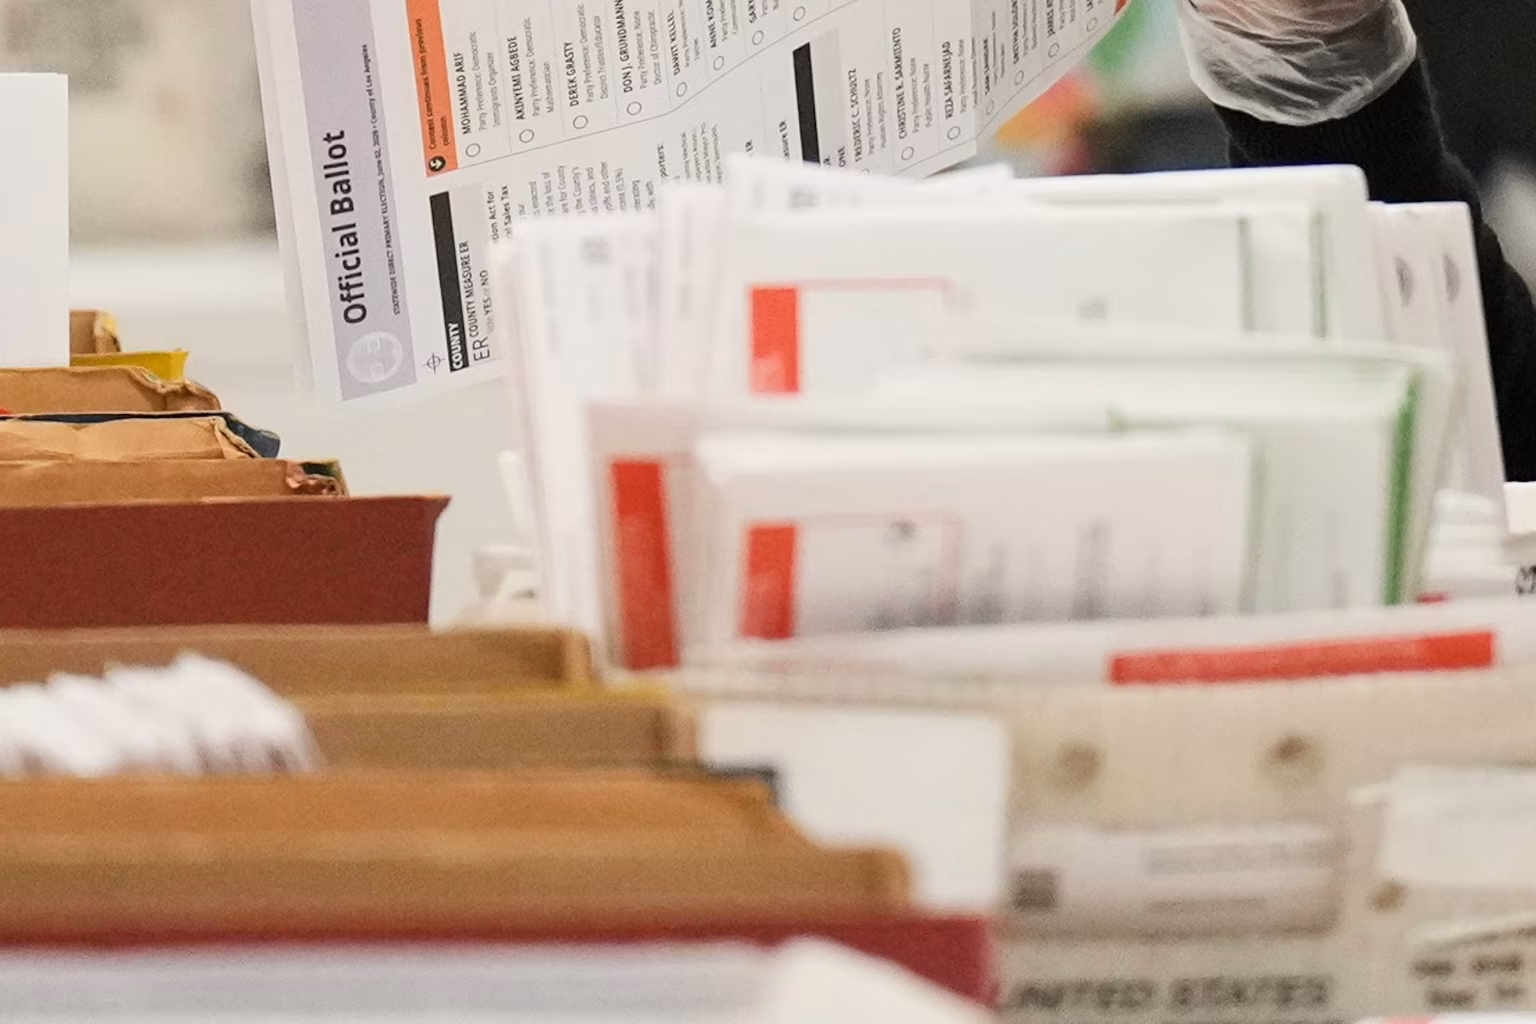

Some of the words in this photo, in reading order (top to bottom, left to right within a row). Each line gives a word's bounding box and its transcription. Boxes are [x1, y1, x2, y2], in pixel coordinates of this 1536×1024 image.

[747, 0, 757, 24] GARY
[415, 18, 427, 54] previous
[707, 21, 717, 48] ANNE
[419, 54, 428, 76] from
[453, 52, 465, 73] ARIF
[506, 35, 520, 72] AGBEDE
[563, 42, 576, 76] GRASTY
[891, 27, 904, 81] SARMIENTO
[422, 75, 433, 117] continues
[511, 73, 525, 120] AKINYEMI
[567, 76, 579, 107] DEREK
[622, 70, 633, 93] DON
[847, 67, 859, 109] SCHULTZ
[455, 74, 471, 135] MOHAMMAD
[851, 108, 860, 118] C.
[895, 90, 907, 140] CHRISTINE
[427, 118, 437, 150] Contest
[439, 115, 450, 146] column
[851, 118, 863, 163] FREDERIC
[322, 129, 354, 216] Ballot
[486, 191, 495, 204] for
[500, 185, 509, 201] Tax
[488, 204, 496, 220] Act
[502, 202, 512, 226] Sales
[459, 240, 469, 254] ER
[331, 222, 367, 324] Official
[460, 254, 474, 299] MEASURE
[479, 269, 488, 287] NO
[465, 300, 479, 338] COUNTY
[482, 296, 492, 316] YES
[448, 322, 463, 369] COUNTY
[471, 336, 490, 361] ER
